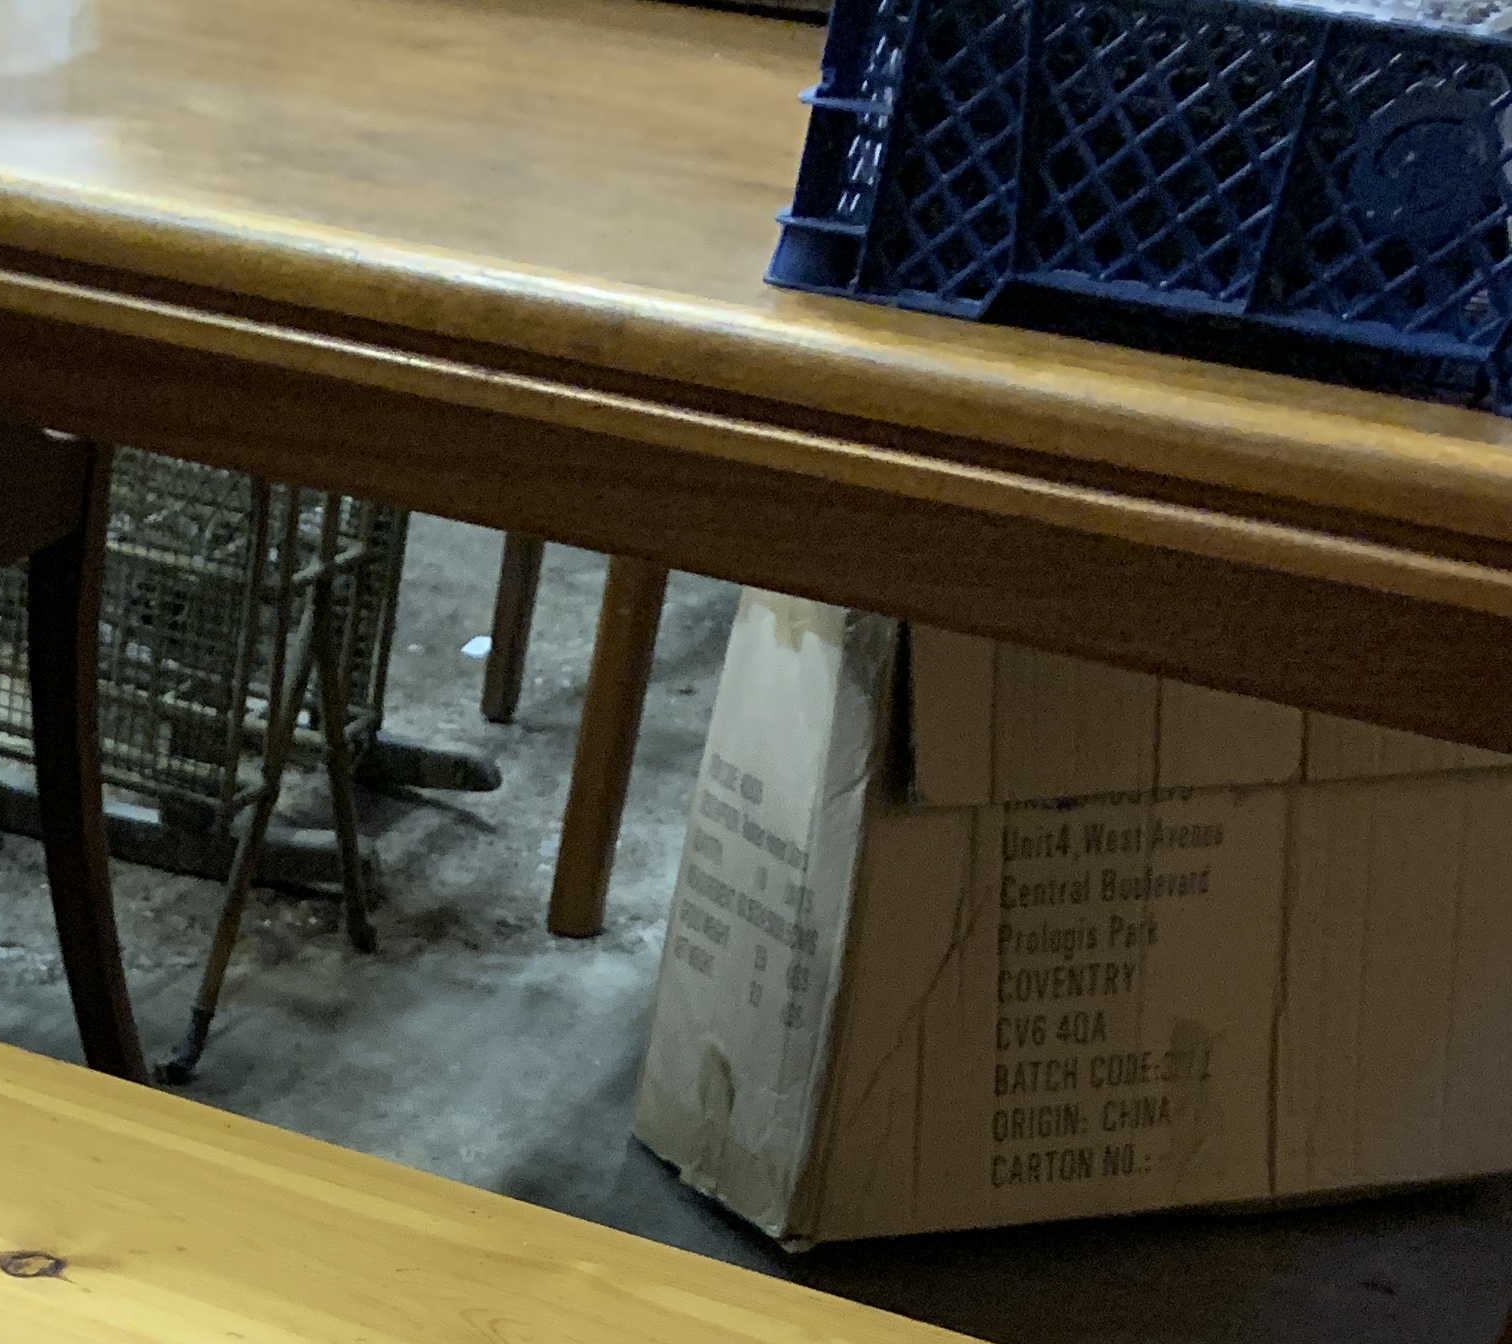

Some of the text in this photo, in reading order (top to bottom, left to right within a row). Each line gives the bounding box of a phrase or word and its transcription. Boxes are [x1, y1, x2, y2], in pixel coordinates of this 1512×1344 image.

[1000, 868, 1091, 910] Central
[996, 962, 1136, 1003] COVENTRY
[996, 1014, 1047, 1051] CV6
[993, 1055, 1079, 1097] BATCH
[991, 1095, 1172, 1142] ORIGIN: CHINA
[990, 1146, 1092, 1188] CARTON
